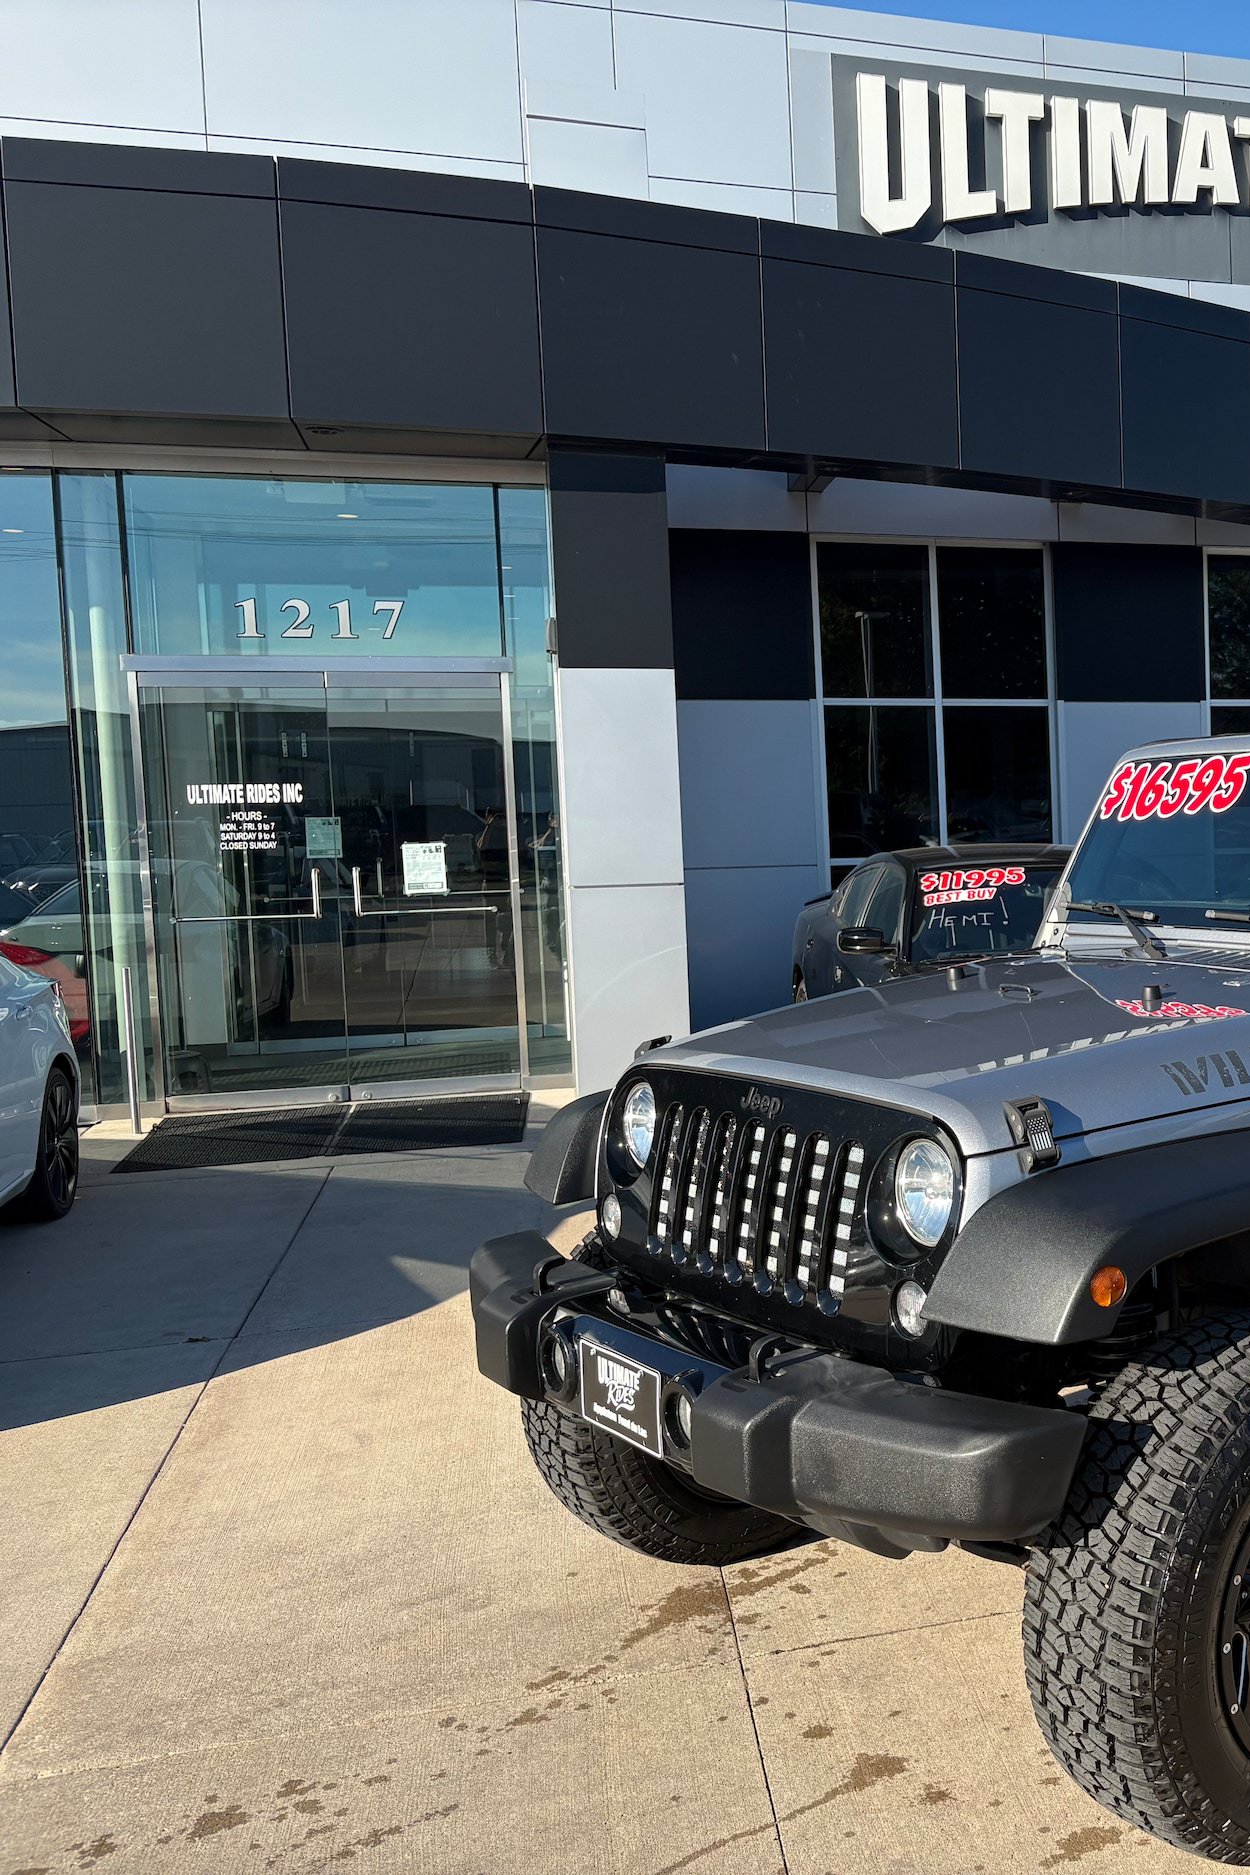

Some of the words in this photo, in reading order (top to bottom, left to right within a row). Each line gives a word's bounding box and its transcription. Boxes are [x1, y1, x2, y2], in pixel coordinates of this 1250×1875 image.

[233, 597, 405, 639] 1217
[186, 783, 244, 805] ULTIMATE
[246, 783, 280, 804] RIDES
[282, 782, 304, 804] INC
[219, 823, 238, 831] MON.
[257, 822, 263, 831] 9
[263, 822, 270, 831] to
[270, 822, 276, 830] 7
[231, 811, 263, 821] HOURS
[219, 841, 248, 850] CLOSED
[249, 840, 278, 850] SUNDAY
[220, 832, 257, 841] SATURDAY
[257, 832, 263, 840] 9
[263, 832, 270, 840] to
[920, 867, 1026, 892] $11995
[924, 891, 962, 907] BEST
[966, 887, 997, 900] BUY
[740, 1086, 783, 1119] Jeep
[597, 1355, 640, 1391] ULTIMATE
